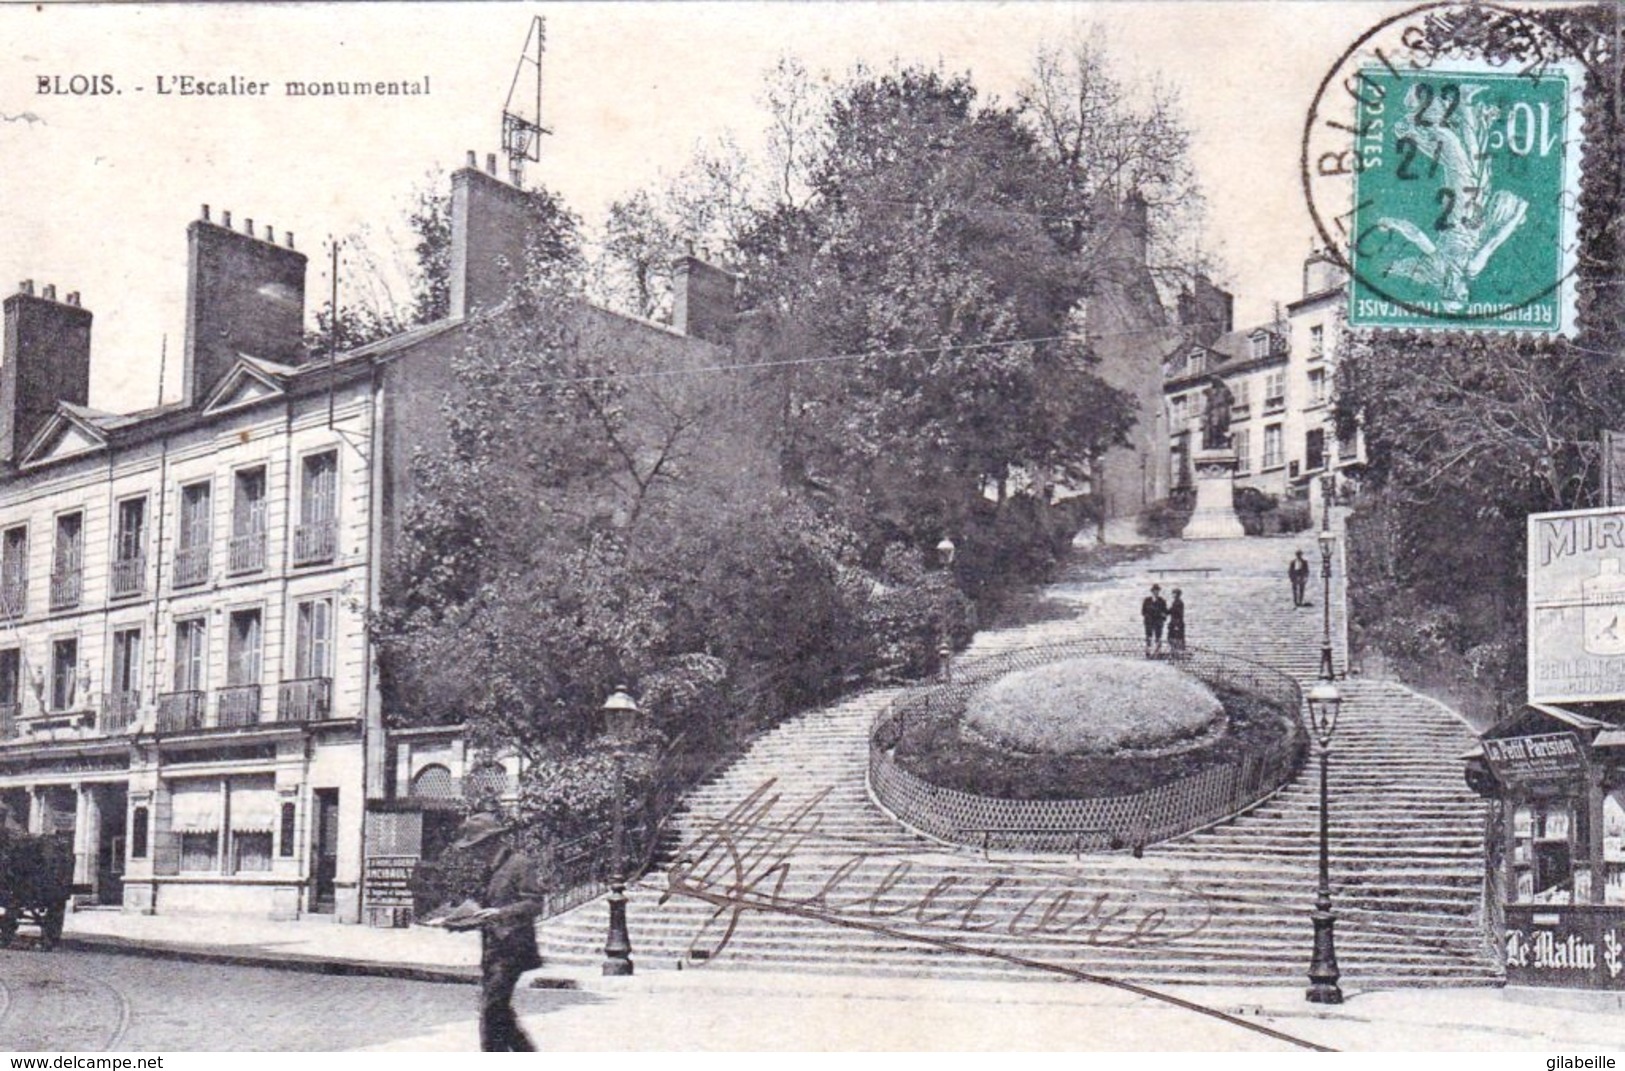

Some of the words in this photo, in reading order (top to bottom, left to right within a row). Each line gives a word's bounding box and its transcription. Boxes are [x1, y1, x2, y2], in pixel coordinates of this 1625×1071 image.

[1361, 84, 1387, 169] POSTES
[1524, 735, 1577, 757] Parisien
[1505, 929, 1530, 967] Le
[1531, 930, 1596, 969] Matin
